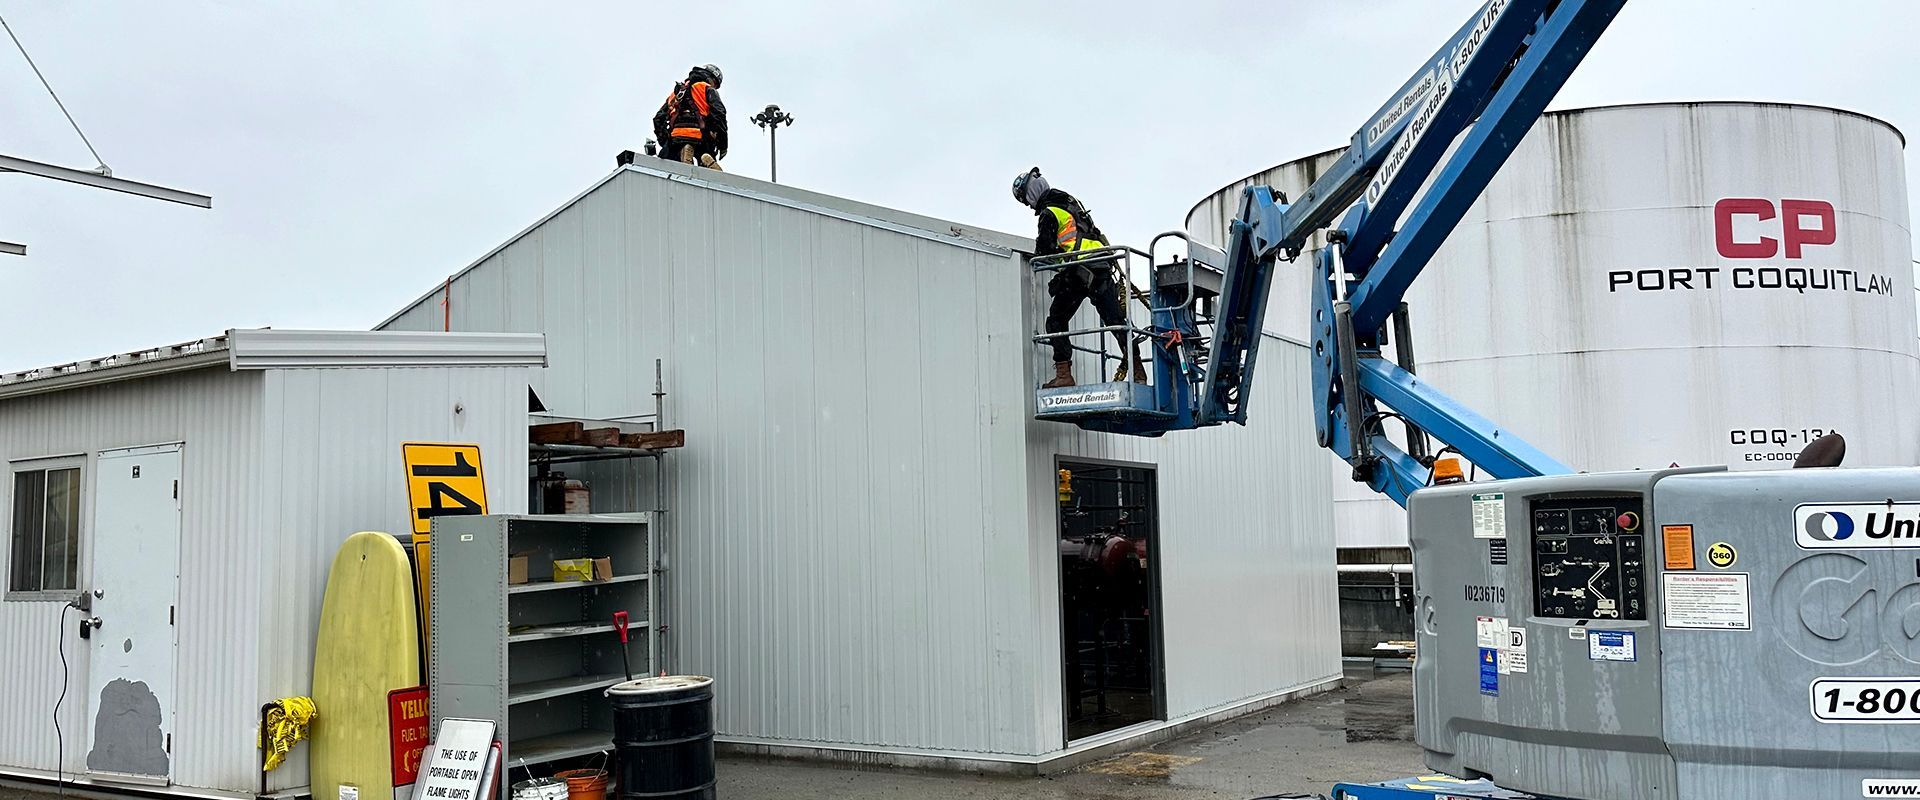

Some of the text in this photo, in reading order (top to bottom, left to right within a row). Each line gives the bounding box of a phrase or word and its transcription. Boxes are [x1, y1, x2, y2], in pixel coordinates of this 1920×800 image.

[1379, 77, 1432, 134] United Rentals
[1381, 137, 1411, 186] United
[1411, 80, 1448, 141] Rentals
[1714, 198, 1836, 259] CP
[1608, 268, 1893, 296] PORT COQUITLAM
[1055, 393, 1115, 406] United Rentals
[1730, 429, 1836, 447] COQ-13
[411, 451, 483, 519] 14
[1464, 584, 1505, 603] 10236719
[1511, 631, 1523, 646] D
[401, 728, 417, 743] FUEL
[441, 749, 478, 761] THE USE OF
[429, 767, 479, 780] PORTABLE OPEN
[427, 786, 470, 800] FLAME LIGHTS
